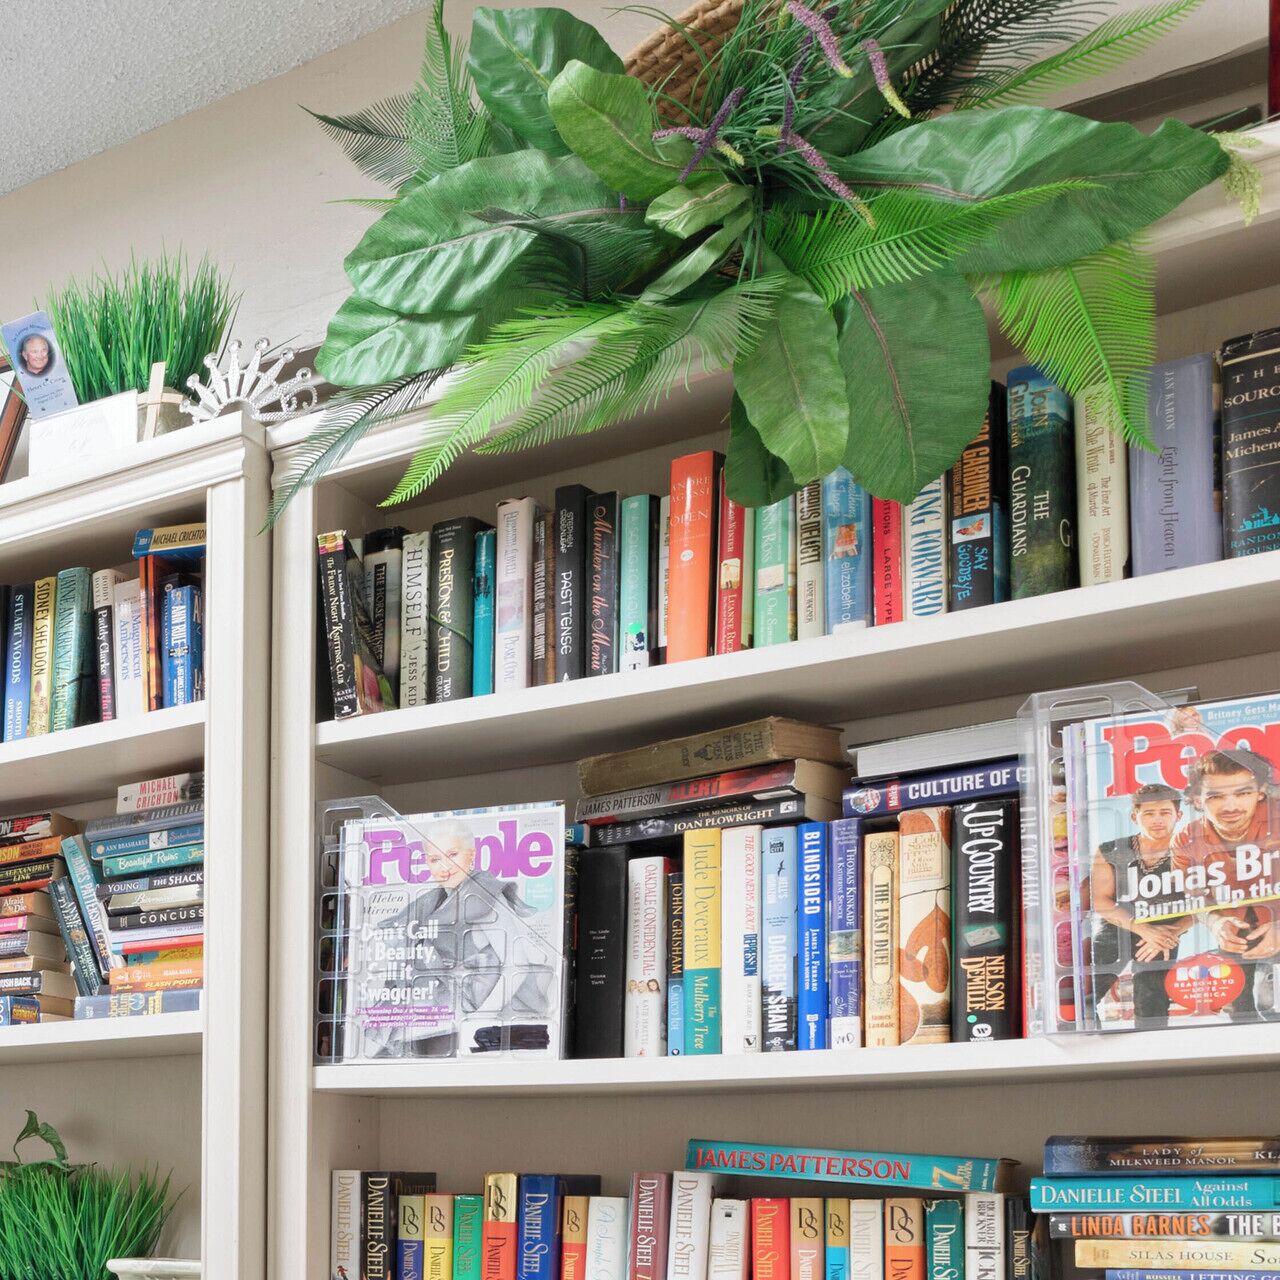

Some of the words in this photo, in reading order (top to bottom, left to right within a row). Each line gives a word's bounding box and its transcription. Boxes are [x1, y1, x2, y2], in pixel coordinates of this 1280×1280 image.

[1010, 464, 1028, 557] GUARDIANS
[912, 530, 943, 617] FORWARD
[953, 544, 972, 600] GOODBYE
[976, 547, 988, 570] SAY
[35, 581, 50, 619] SIDNEY
[405, 548, 423, 638] HIMSELF
[560, 570, 573, 608] PAST
[96, 609, 108, 639] Paddy
[559, 611, 572, 656] TENSE
[33, 622, 50, 677] SHELDON
[98, 642, 110, 676] Clarke
[908, 774, 984, 800] CULTURE
[990, 769, 1011, 787] OF
[674, 817, 700, 832] JOAN
[703, 808, 775, 830] PLOWRIGHT
[695, 843, 715, 880] Jude
[803, 831, 820, 915] BLINDSIDED
[1118, 857, 1227, 903] Jonas
[371, 894, 403, 904] Helen
[695, 886, 716, 963] Deveraux
[14, 977, 32, 988] BACK
[694, 975, 709, 1022] Mulberry
[985, 955, 1005, 1011] NELSON
[695, 1026, 708, 1050] Tree
[696, 1148, 767, 1169] JAMES
[770, 1153, 911, 1181] PATTERSON
[1109, 1158, 1181, 1167] MILKWEED
[1185, 1157, 1237, 1166] MANOR
[1041, 1185, 1126, 1204] DANIELLE
[1129, 1185, 1184, 1204] STEEL
[1190, 1196, 1209, 1207] All
[1209, 1196, 1253, 1208] Odds
[1192, 1181, 1249, 1195] Against
[1071, 1216, 1124, 1236] LINDA
[1132, 1215, 1211, 1235] BARNES
[1226, 1214, 1264, 1235] THE
